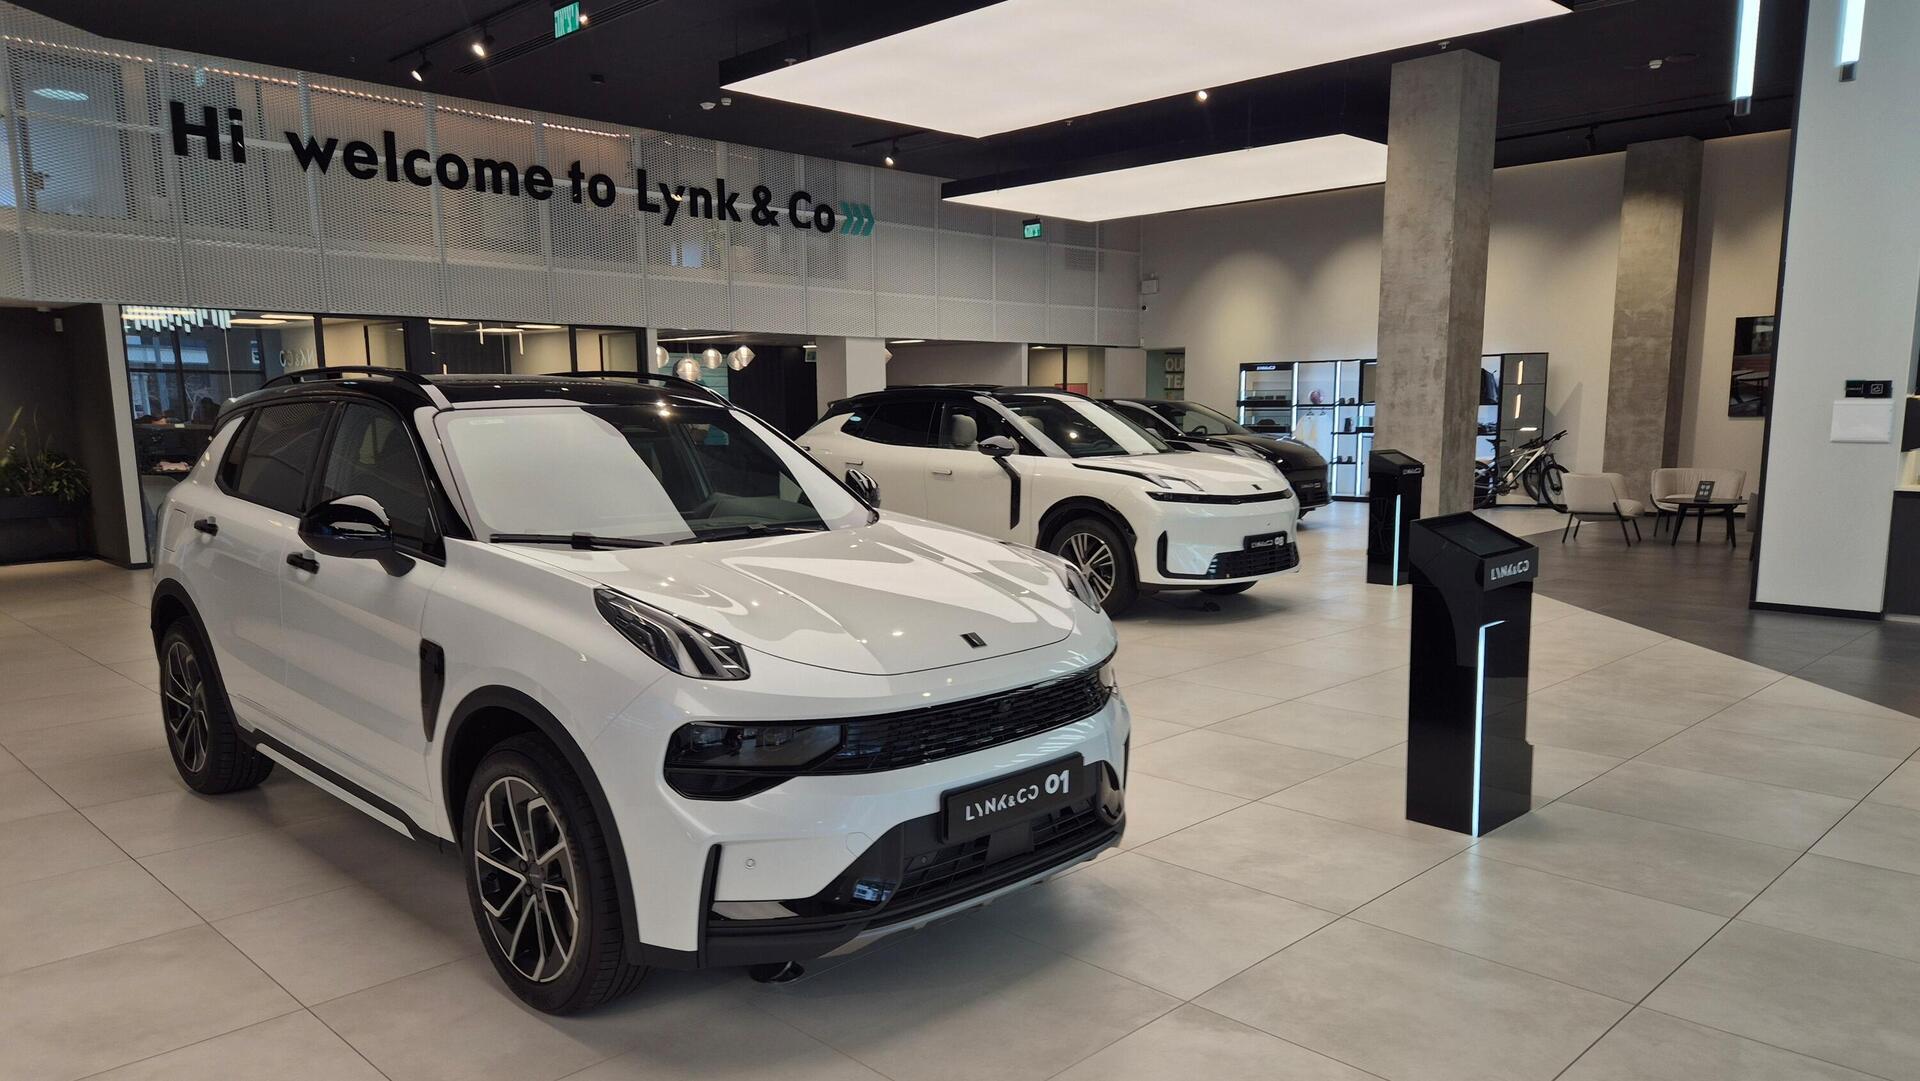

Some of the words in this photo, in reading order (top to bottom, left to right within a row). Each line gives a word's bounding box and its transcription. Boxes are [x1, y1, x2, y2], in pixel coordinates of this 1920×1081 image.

[170, 101, 246, 163] Hi
[284, 130, 554, 200] welcome
[568, 160, 616, 207] to
[637, 168, 742, 226] Lynk
[751, 185, 779, 227] &
[789, 191, 835, 233] Co
[965, 784, 1039, 821] LYNK&CO
[1044, 769, 1070, 795] 01
